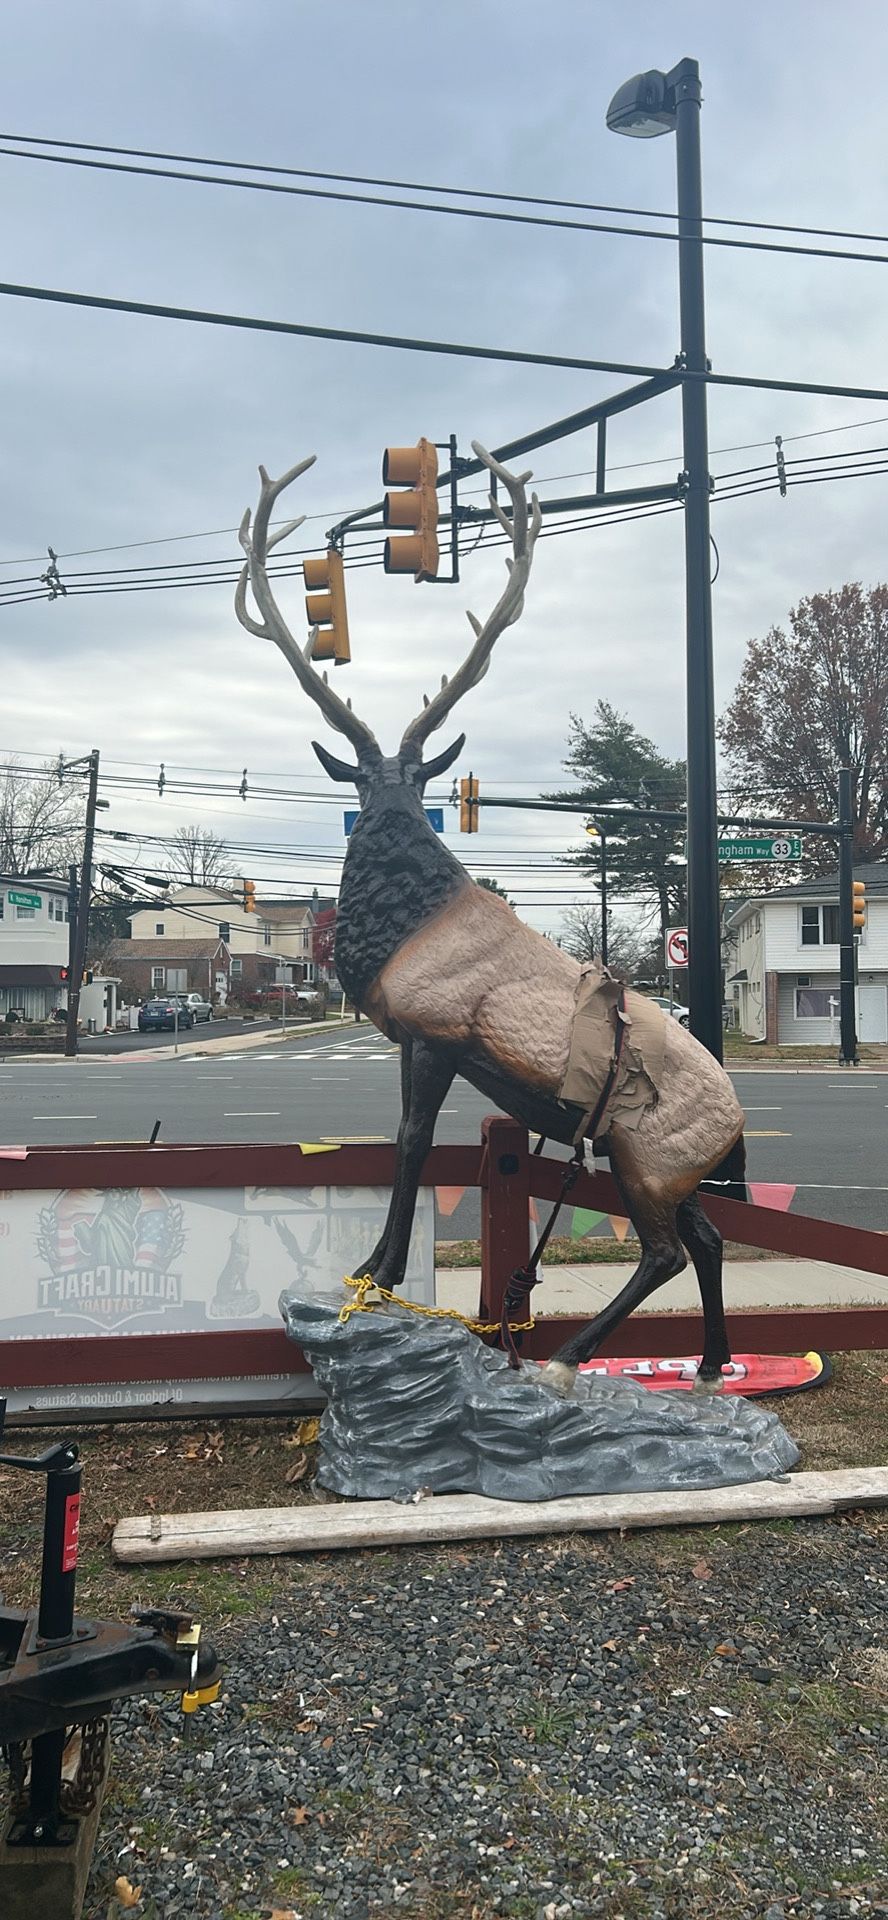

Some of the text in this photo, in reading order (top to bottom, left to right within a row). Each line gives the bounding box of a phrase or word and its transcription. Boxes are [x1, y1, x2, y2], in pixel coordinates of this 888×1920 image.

[718, 844, 769, 858] ngham Way
[775, 843, 789, 855] 33
[794, 841, 799, 849] E
